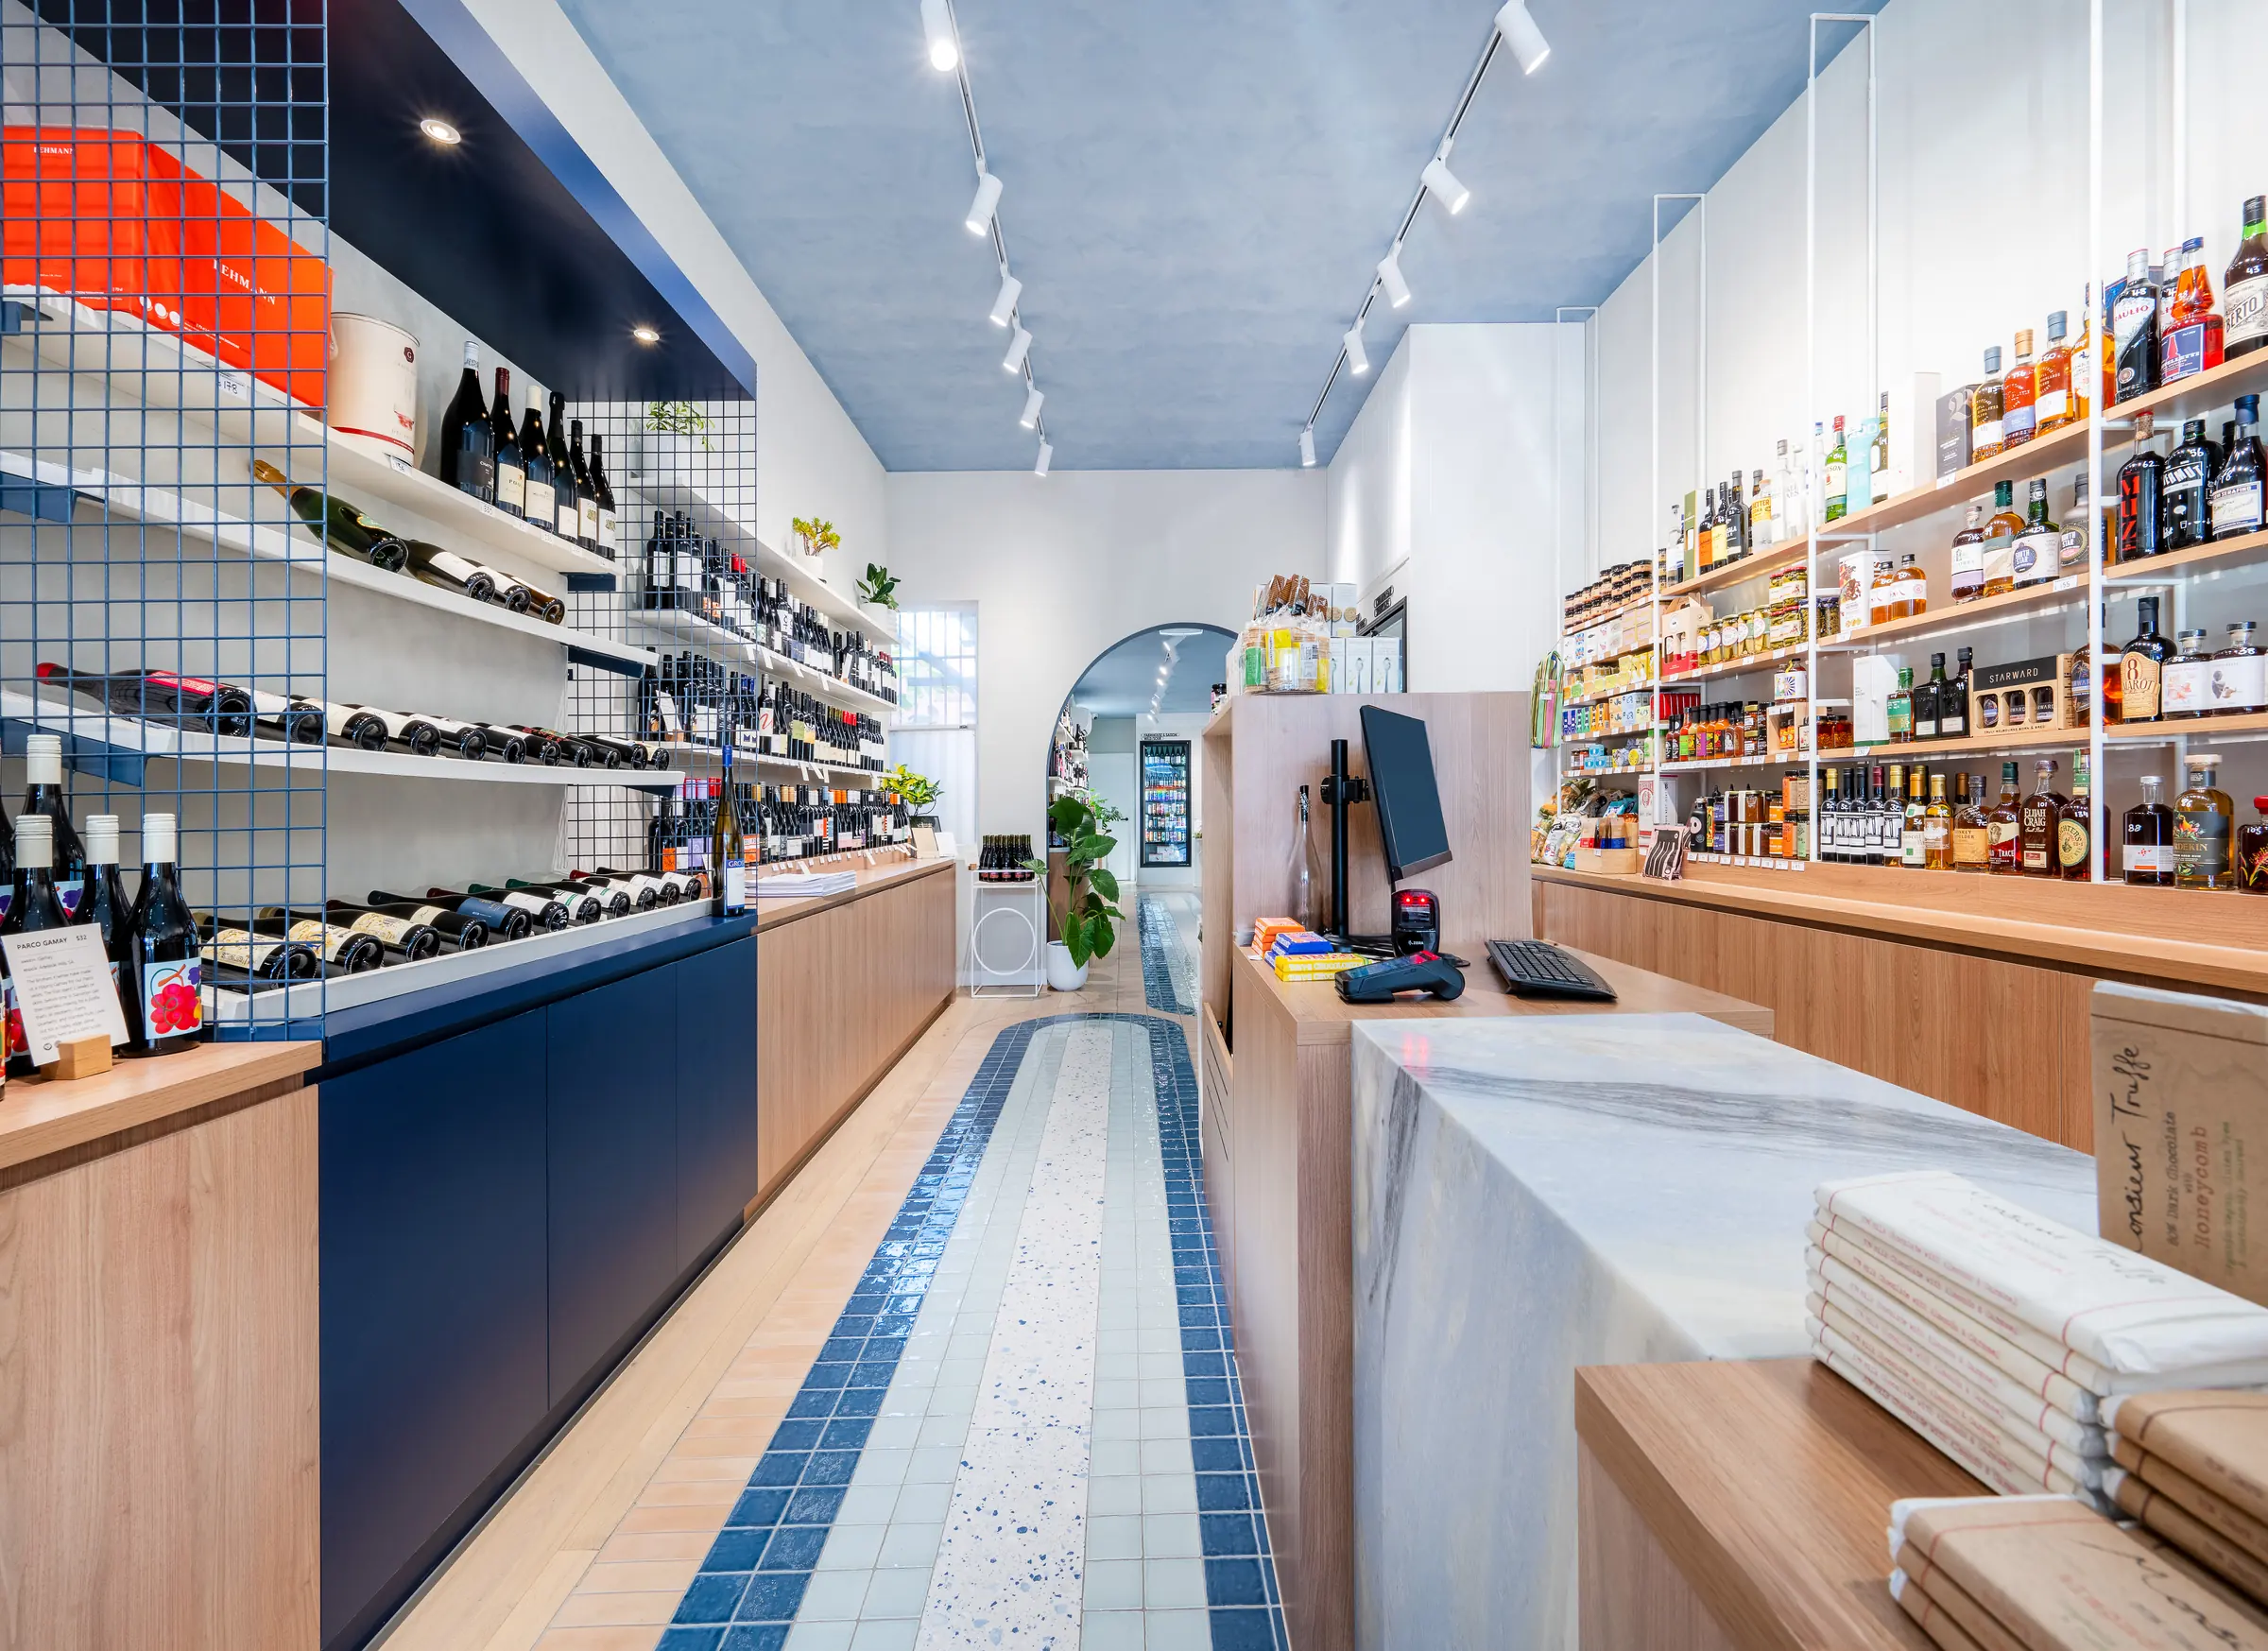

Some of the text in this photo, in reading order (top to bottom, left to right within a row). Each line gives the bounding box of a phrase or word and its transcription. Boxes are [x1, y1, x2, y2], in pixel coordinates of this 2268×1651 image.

[2246, 266, 2260, 274] 43
[2132, 288, 2147, 297] 48
[2190, 449, 2204, 457] 56
[2062, 539, 2075, 548] STAR
[2015, 557, 2029, 565] STAR
[1989, 667, 2039, 684] STARWARD
[2127, 659, 2139, 680] 8
[2023, 807, 2047, 818] ELIJAH
[2023, 817, 2046, 828] CRAIG
[17, 941, 42, 950] PARCO
[43, 937, 68, 946] GAMAY
[2109, 1045, 2152, 1254] onsieur Truffe
[2162, 1111, 2179, 1182] Chocolate
[2190, 1126, 2215, 1250] Honeycomb
[2166, 1186, 2179, 1218] Dark
